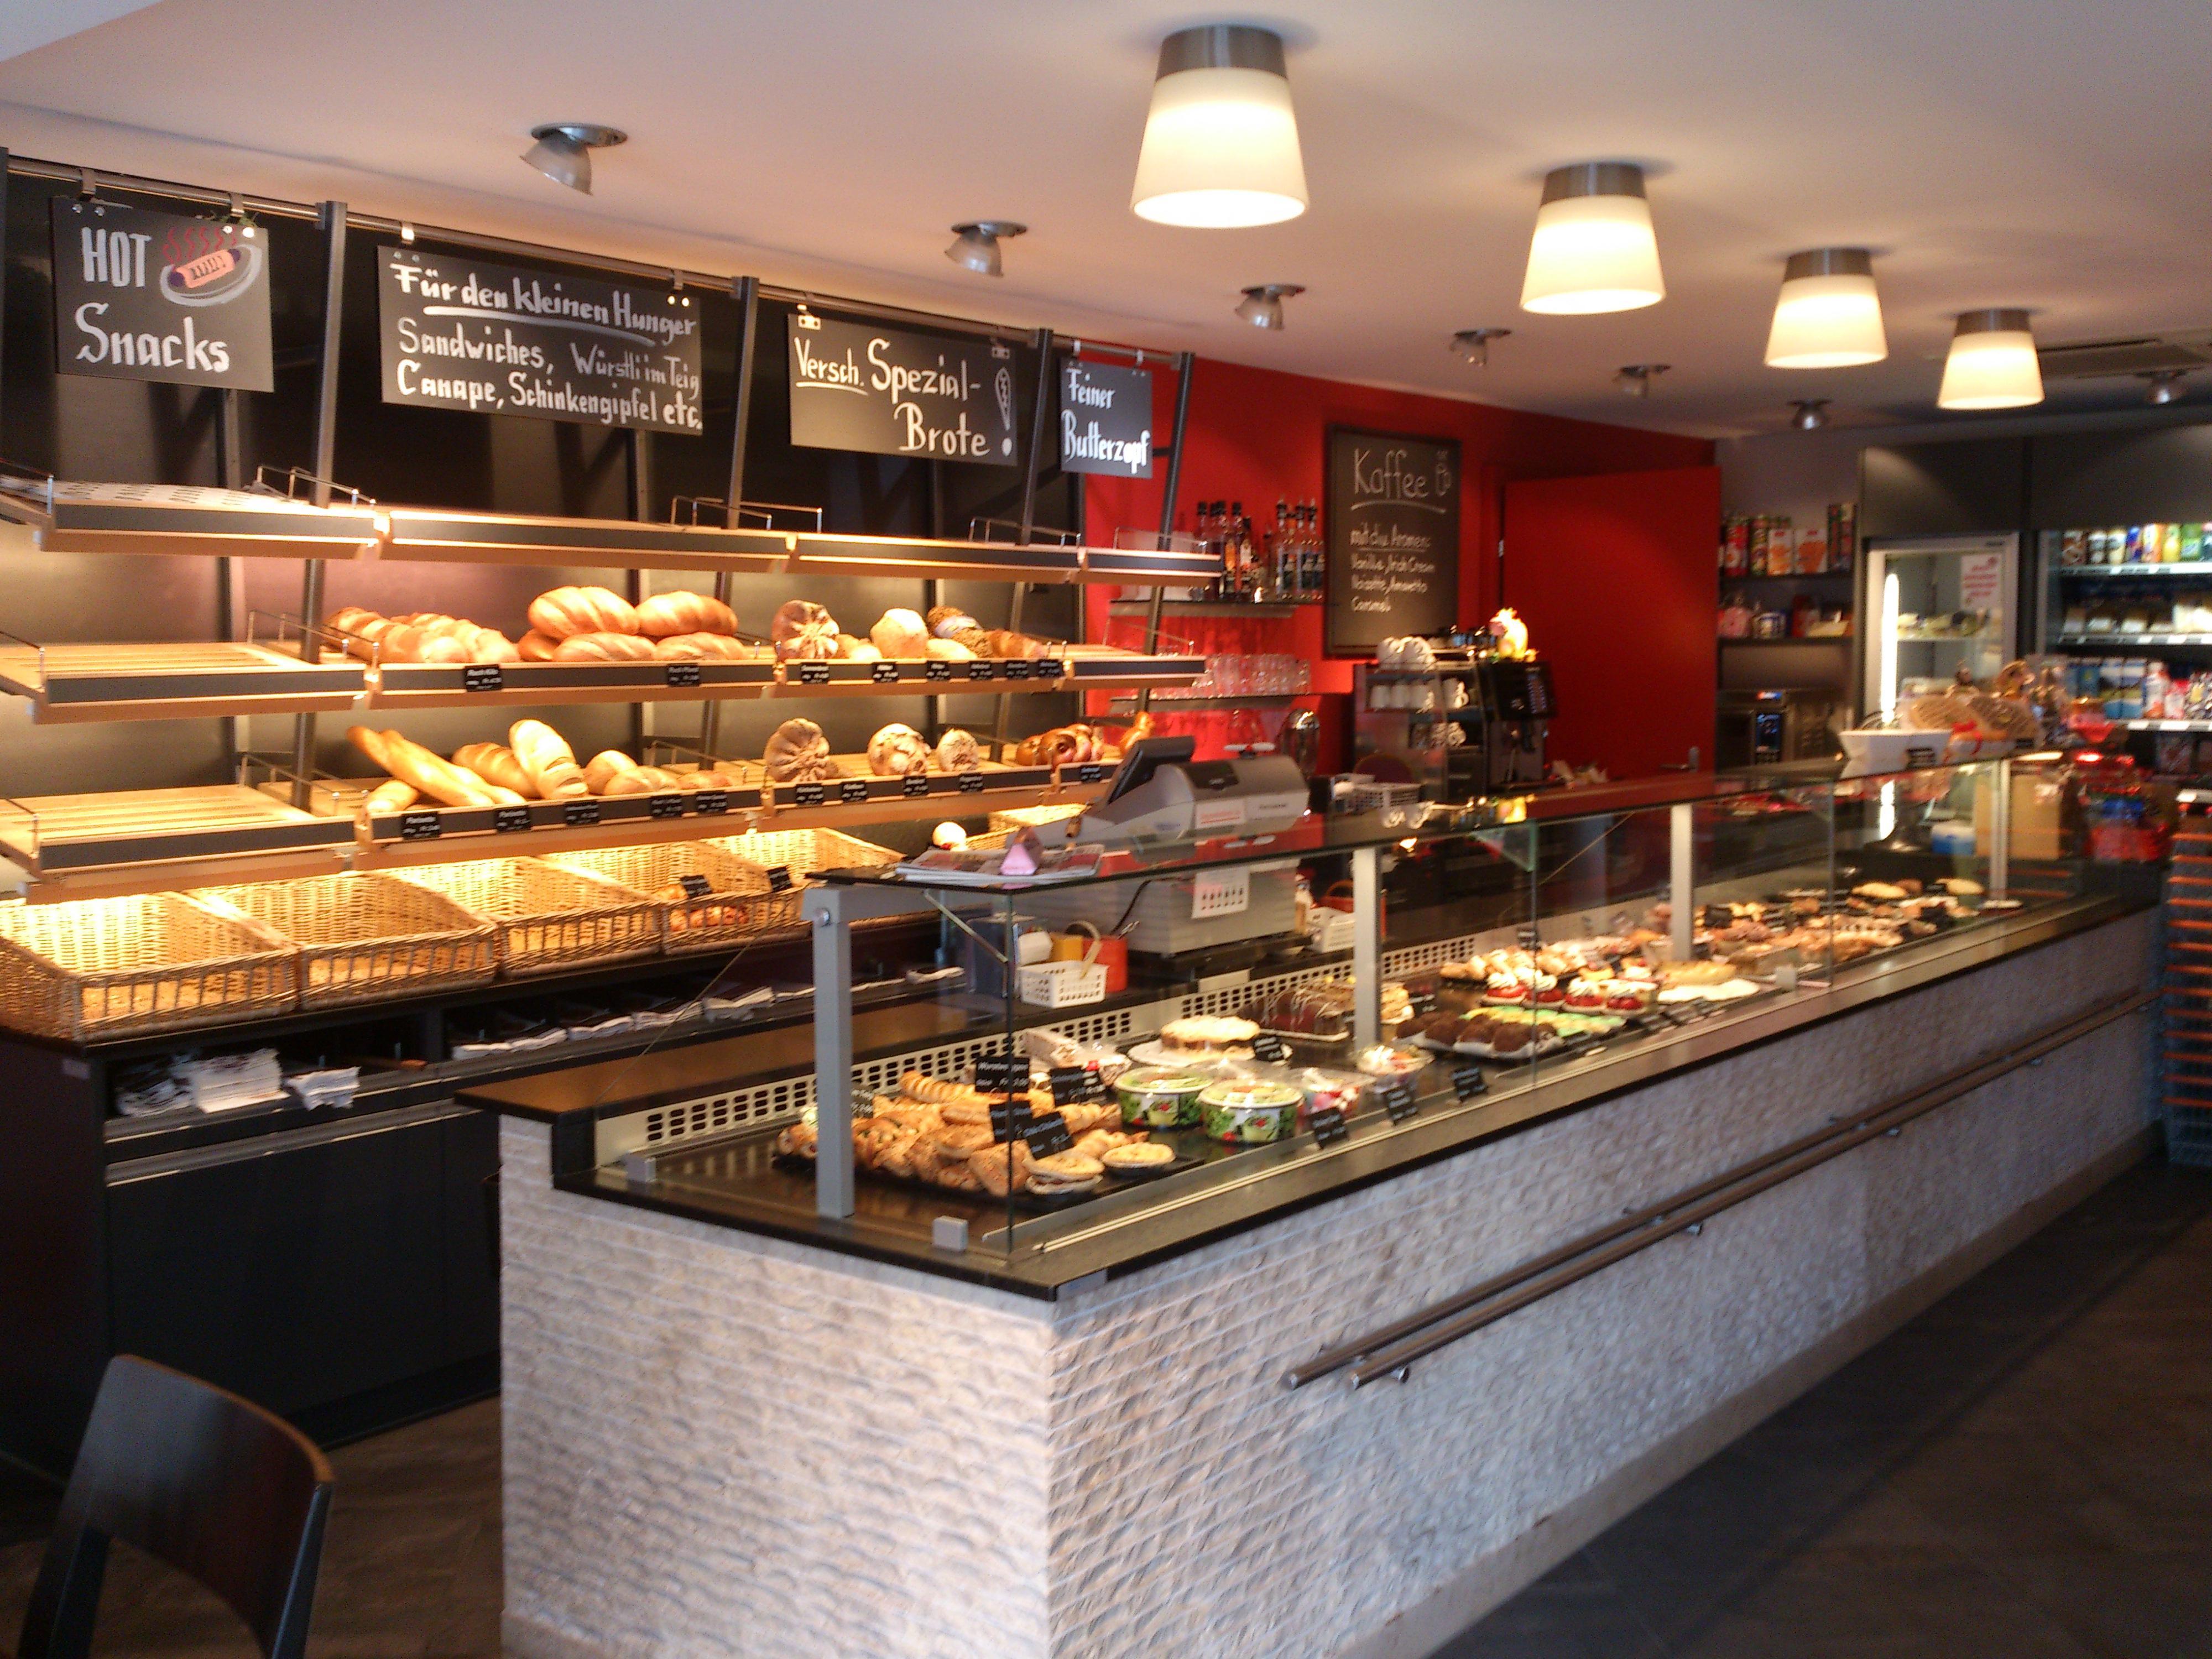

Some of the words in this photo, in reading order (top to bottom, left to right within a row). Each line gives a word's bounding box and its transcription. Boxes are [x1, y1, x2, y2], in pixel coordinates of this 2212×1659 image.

[81, 227, 152, 288] HOT
[390, 262, 458, 301] Für
[460, 272, 509, 310] den
[512, 276, 609, 326] kleinen
[612, 289, 698, 345] Hunger
[75, 302, 231, 374] Snacks
[398, 317, 555, 376] Sandwiches,
[663, 354, 700, 401] Teig
[793, 336, 865, 386] Versch.
[867, 337, 982, 405] Spezial-
[396, 358, 505, 410] Canape,
[508, 371, 659, 425] Schinkengipfel
[662, 390, 703, 430] etc.
[1066, 367, 1116, 409] Feiner
[893, 401, 991, 457] Brote
[1061, 409, 1151, 474] Butterzopf
[1354, 448, 1430, 499] Kaffee
